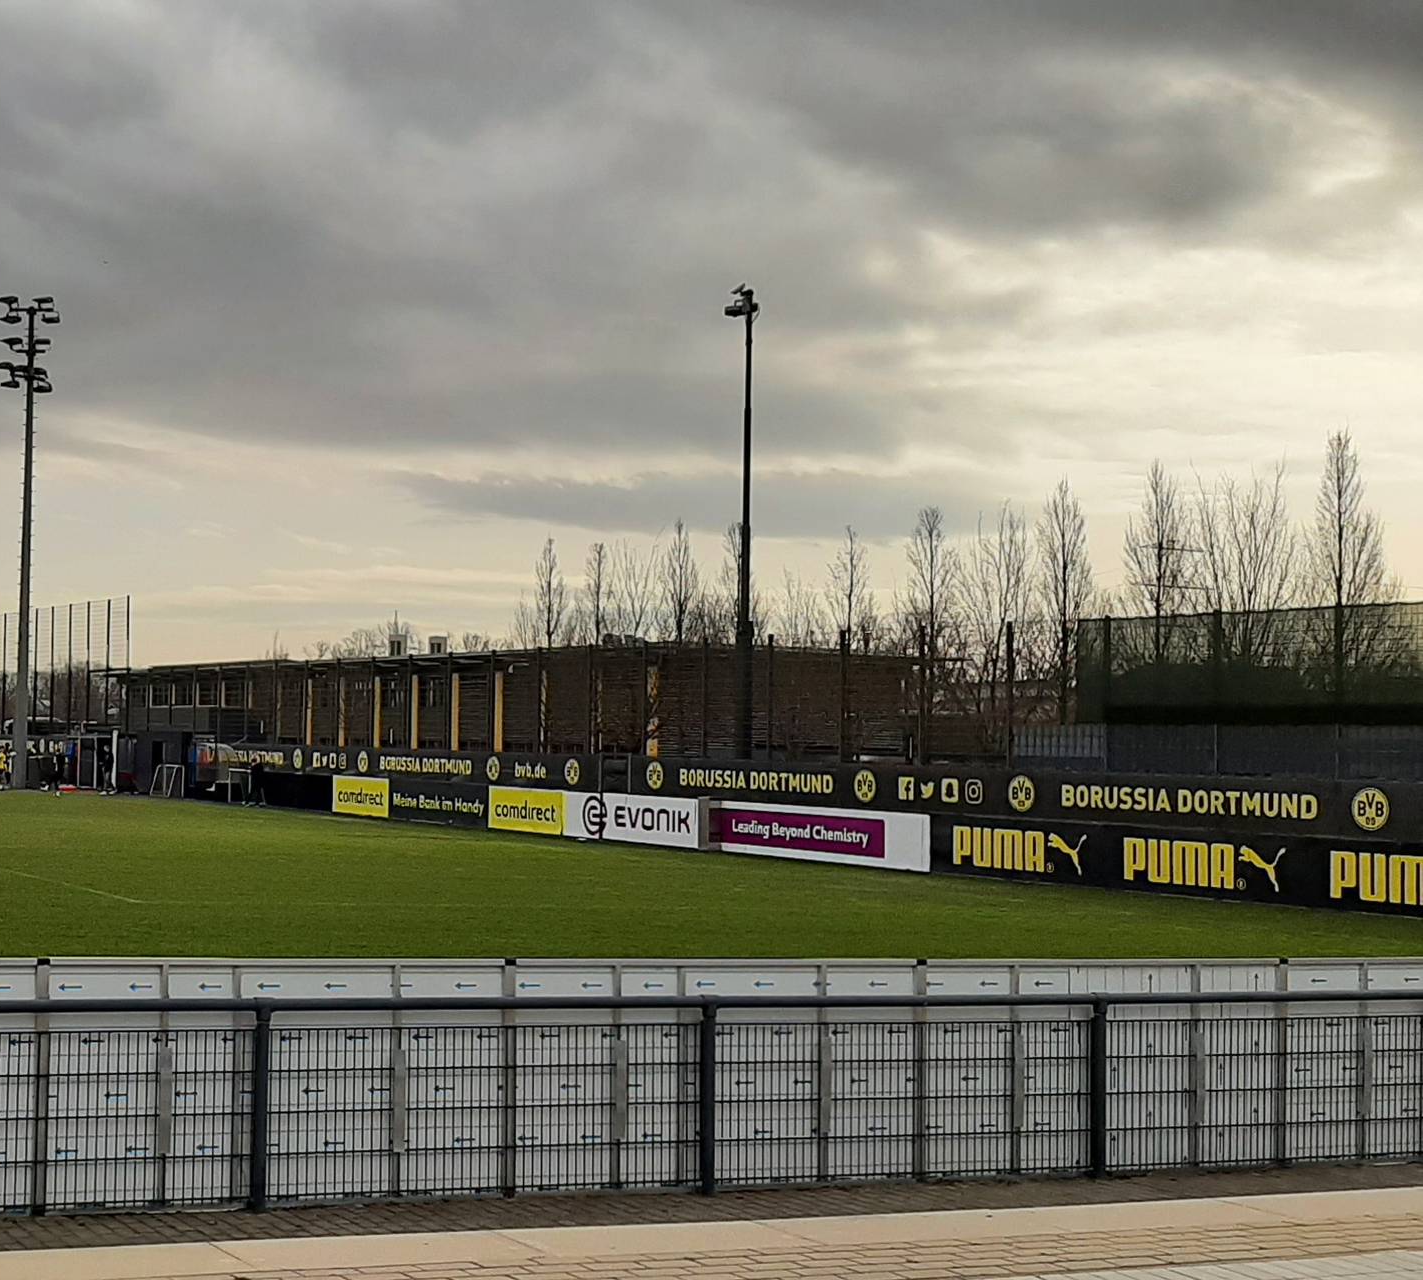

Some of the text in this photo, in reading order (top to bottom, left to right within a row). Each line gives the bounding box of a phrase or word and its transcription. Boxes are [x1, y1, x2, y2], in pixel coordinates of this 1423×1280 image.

[379, 756, 472, 775] BORUSSIA DORTMUND
[515, 762, 547, 778] bvb.de
[679, 768, 834, 794] BORUSSIA DORTMUND
[337, 787, 384, 806] comdirect
[393, 793, 484, 817] Meine Bank im Handy
[1061, 784, 1318, 820] BORUSSIA DORTMUND
[1358, 792, 1385, 817] BVB
[495, 800, 557, 823] comdirect
[614, 806, 691, 834] EVONIK
[732, 819, 869, 848] Leading Beyond Chemistry
[953, 825, 1045, 873] PUMA
[1123, 837, 1235, 890] PUMA
